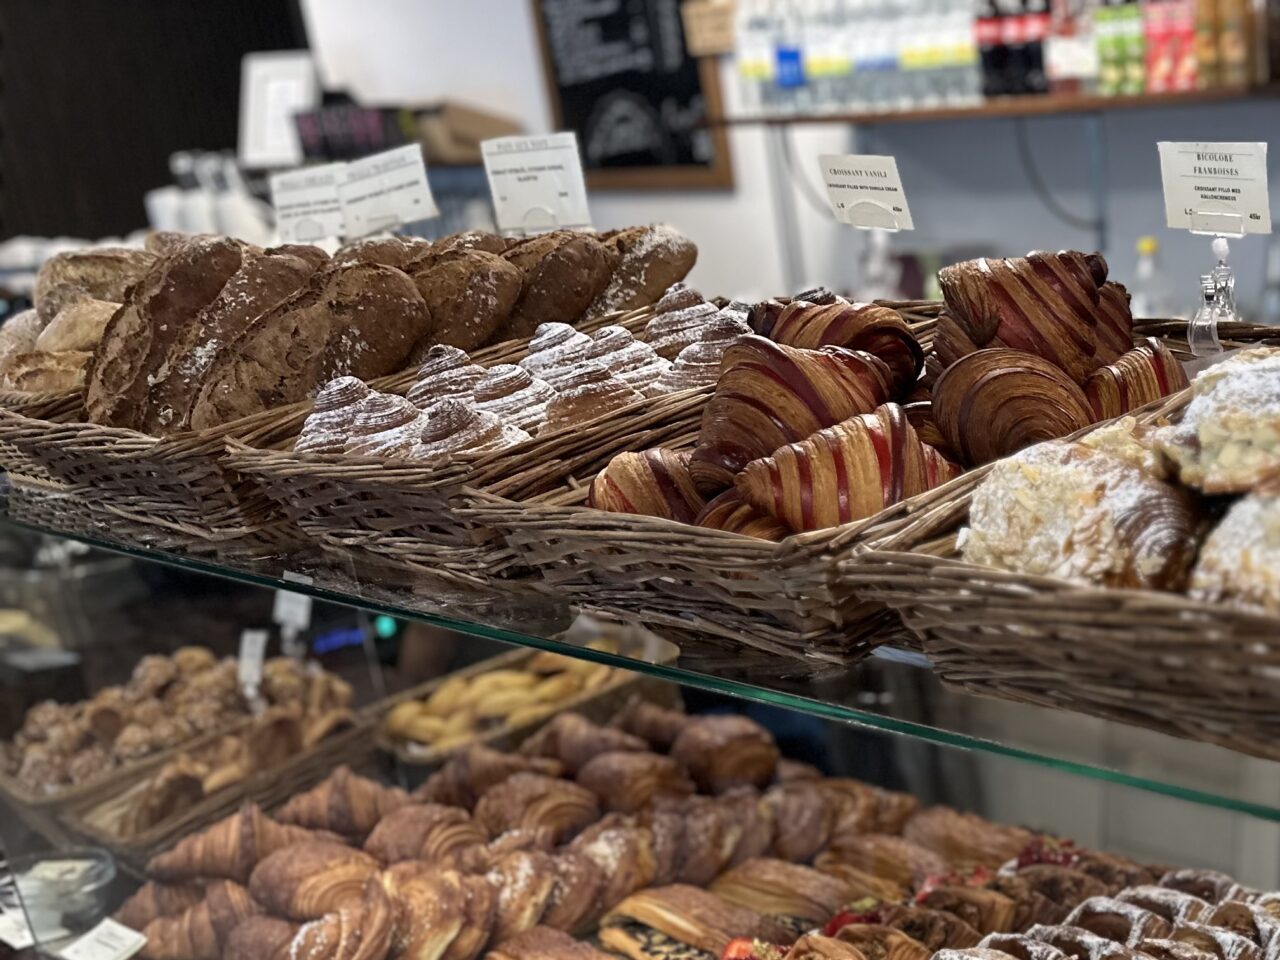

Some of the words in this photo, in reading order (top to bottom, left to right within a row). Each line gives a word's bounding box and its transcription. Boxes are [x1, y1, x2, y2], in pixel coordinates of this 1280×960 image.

[1197, 153, 1233, 162] BICOLORE
[829, 168, 863, 177] CROISSANT
[1194, 167, 1238, 175] FRAMBOISES
